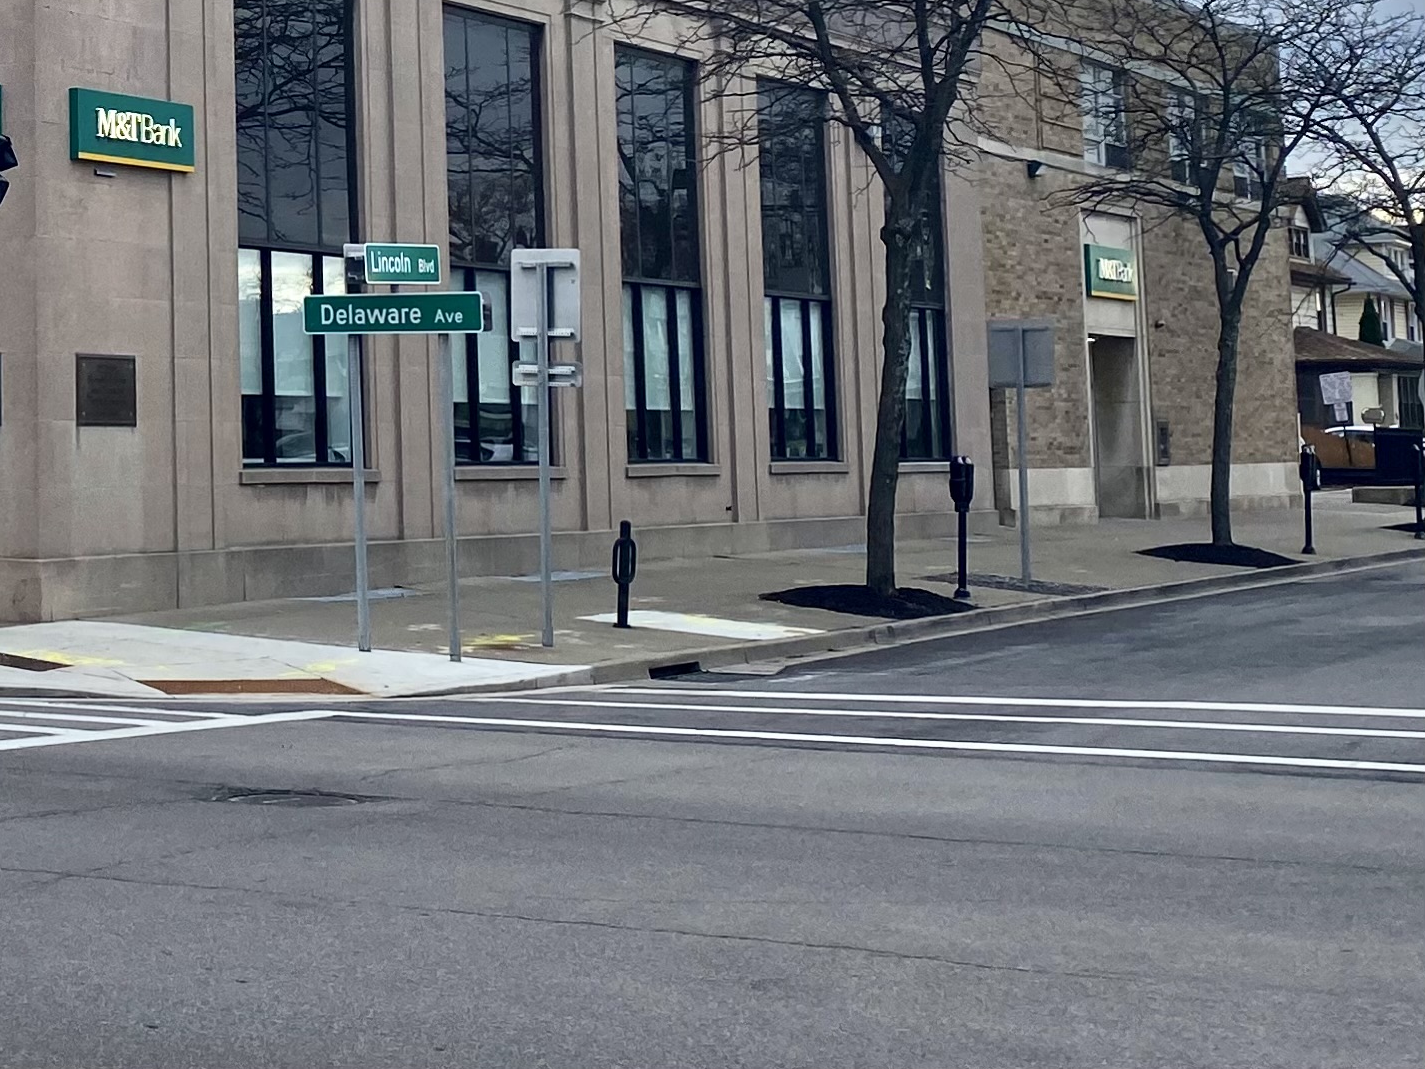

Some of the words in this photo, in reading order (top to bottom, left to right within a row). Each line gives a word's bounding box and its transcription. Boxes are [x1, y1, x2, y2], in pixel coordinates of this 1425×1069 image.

[370, 251, 411, 273] Lincoln
[418, 259, 435, 274] Blvd
[320, 304, 421, 325] Delaware
[434, 309, 464, 323] Ave
